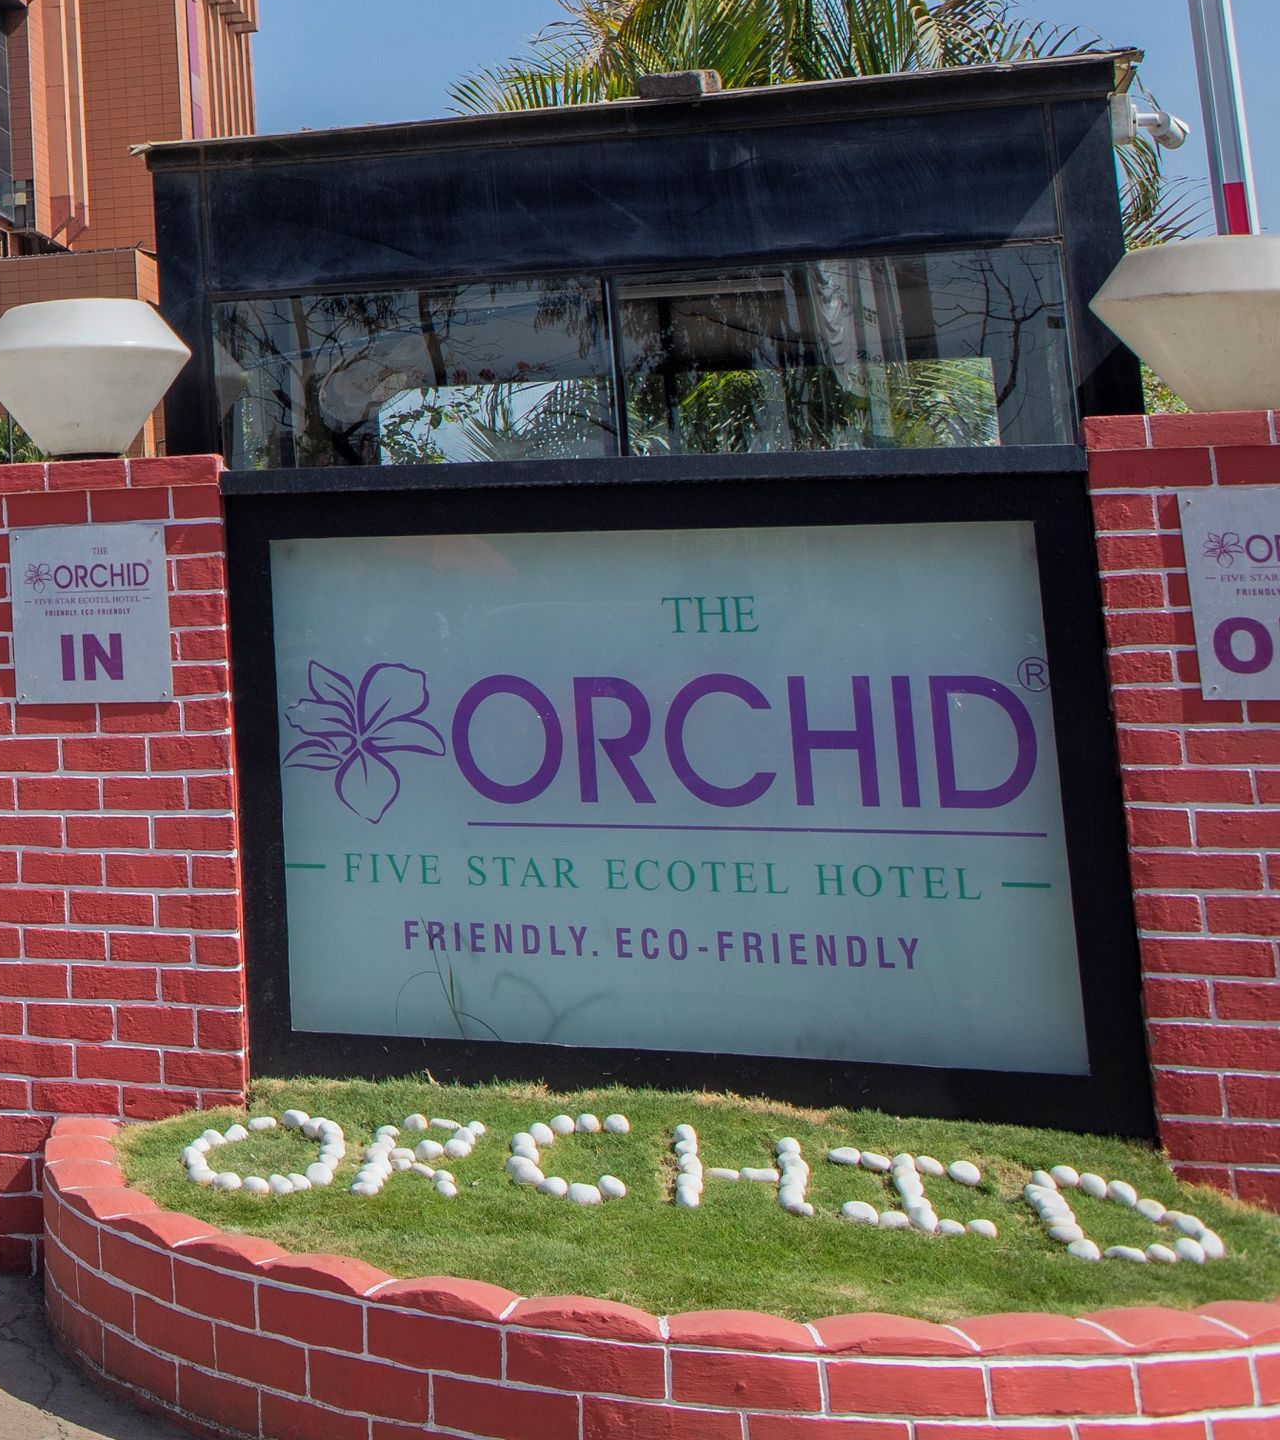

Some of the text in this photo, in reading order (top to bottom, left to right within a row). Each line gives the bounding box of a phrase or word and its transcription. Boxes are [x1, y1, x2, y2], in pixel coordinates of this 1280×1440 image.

[91, 547, 109, 556] THE
[1245, 534, 1280, 563] O
[53, 562, 150, 589] ORCHID
[1220, 573, 1279, 583] FIVE STAR
[34, 595, 141, 606] FIVE STAR ECOTEL HOTEL
[80, 607, 131, 616] ECO-FRIENDLY
[661, 596, 759, 634] THE
[60, 633, 124, 681] IN
[1213, 616, 1280, 674] O
[343, 852, 983, 901] FIVE STAR ECOTEL HOTEL
[403, 919, 920, 970] FRIENDLY. ECO-FRIENDLY
[181, 1108, 1225, 1264] ORCHID
